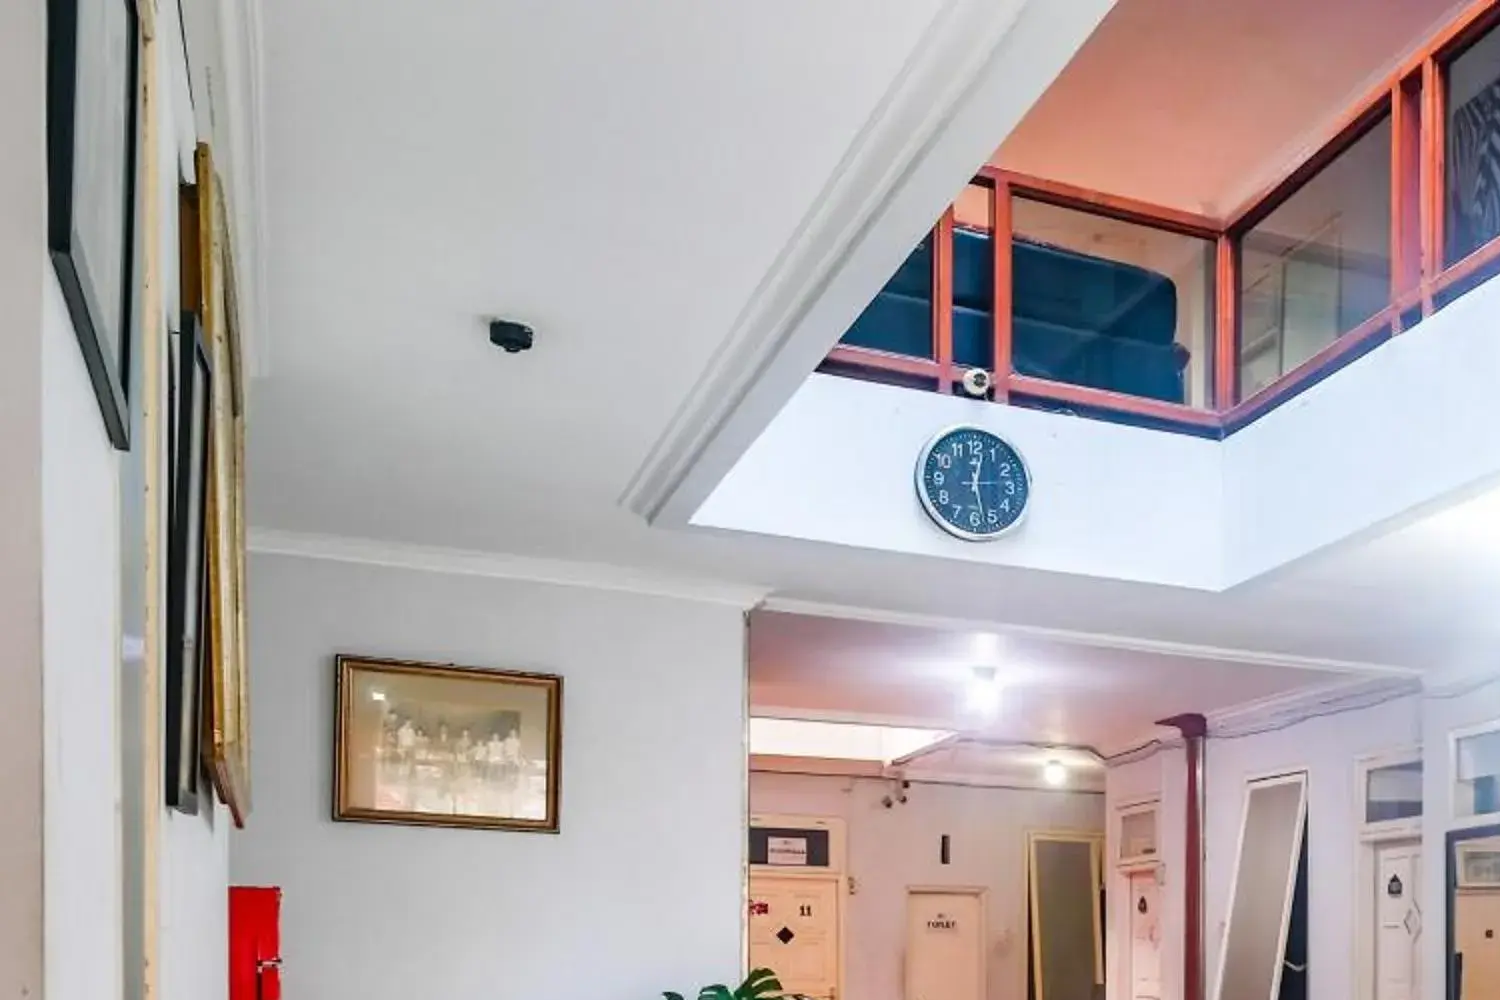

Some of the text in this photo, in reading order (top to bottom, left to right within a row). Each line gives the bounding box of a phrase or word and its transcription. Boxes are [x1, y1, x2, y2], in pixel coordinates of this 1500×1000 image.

[952, 442, 963, 457] 11
[967, 440, 983, 455] 12
[989, 448, 995, 462] 1
[933, 452, 951, 469] 10
[1000, 462, 1011, 477] 2
[933, 471, 945, 486] 9
[1004, 481, 1015, 495] 3
[939, 489, 949, 505] 8
[952, 504, 962, 519] 7
[1000, 498, 1010, 513] 4
[969, 511, 980, 527] 6
[987, 509, 998, 524] 5
[799, 905, 812, 917] 11
